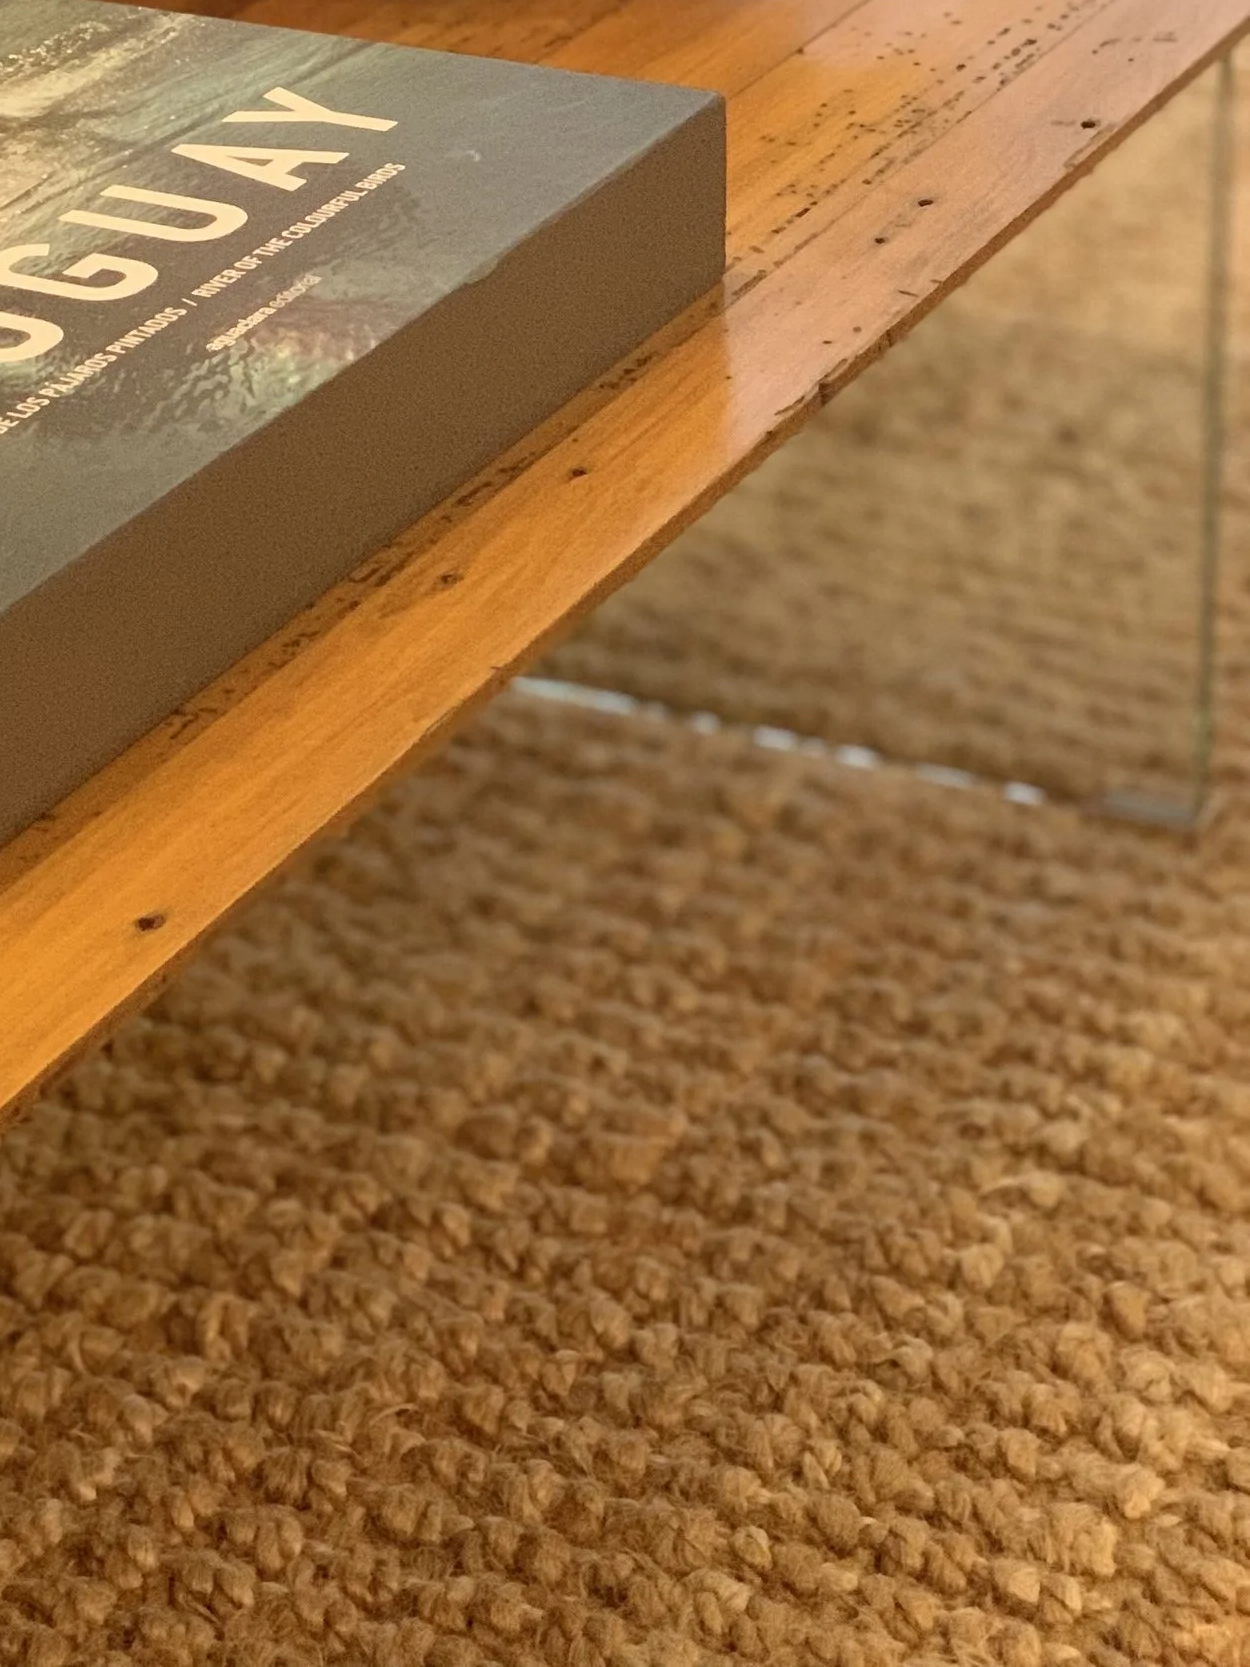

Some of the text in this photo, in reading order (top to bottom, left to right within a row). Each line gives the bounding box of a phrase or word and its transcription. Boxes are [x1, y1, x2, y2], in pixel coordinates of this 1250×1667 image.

[7, 396, 50, 418] LOS
[39, 352, 117, 398] PÁJAROS
[106, 306, 187, 354] PINTADOS
[191, 269, 246, 298] RIVER
[234, 255, 263, 270] OF
[252, 237, 293, 256] THE
[282, 189, 368, 239] COLOURFUL
[355, 162, 406, 190] BIRDS
[206, 306, 277, 352] aguaclara
